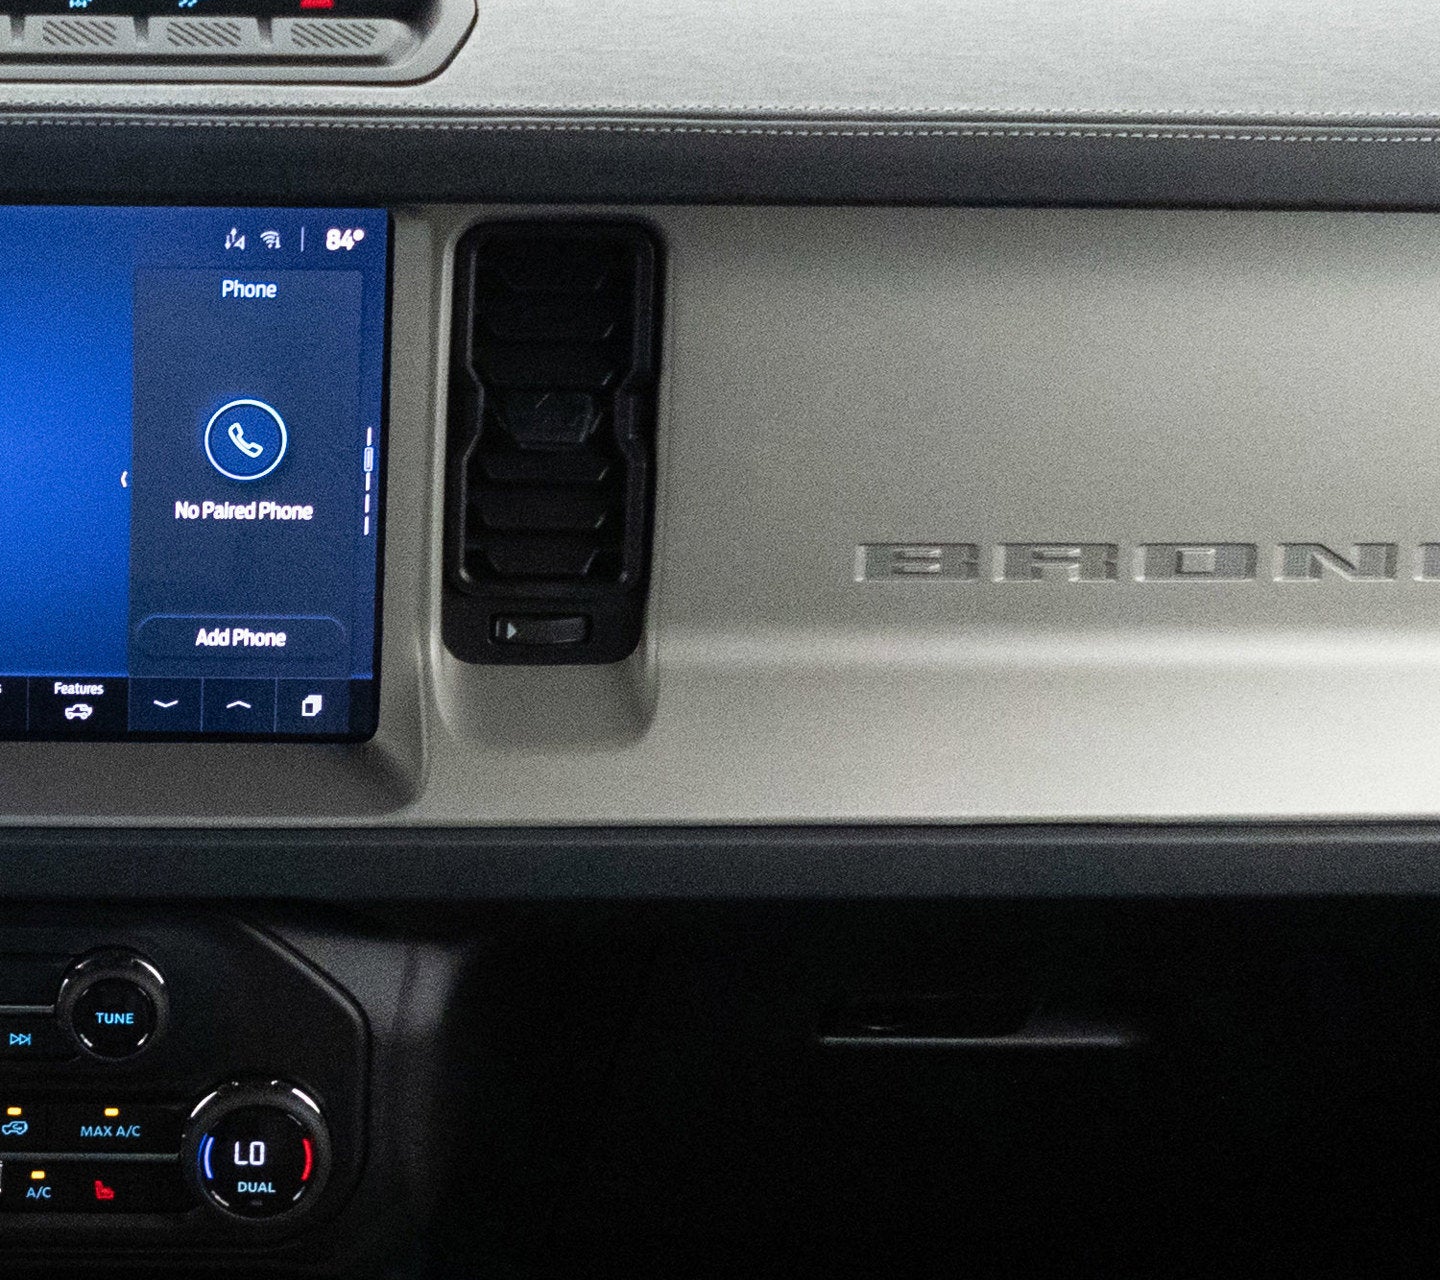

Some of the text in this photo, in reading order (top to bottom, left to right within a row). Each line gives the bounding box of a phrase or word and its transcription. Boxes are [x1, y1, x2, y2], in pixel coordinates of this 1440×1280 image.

[326, 227, 365, 251] 84°
[222, 279, 277, 300] Phone
[175, 500, 314, 521] No Paired Phone
[195, 627, 287, 647] Add Phone
[53, 681, 104, 696] Features
[94, 1013, 135, 1025] TUNE
[79, 1125, 140, 1138] MAX A/C
[233, 1141, 265, 1166] LO
[25, 1185, 52, 1200] A/C
[237, 1180, 275, 1193] DUAL
